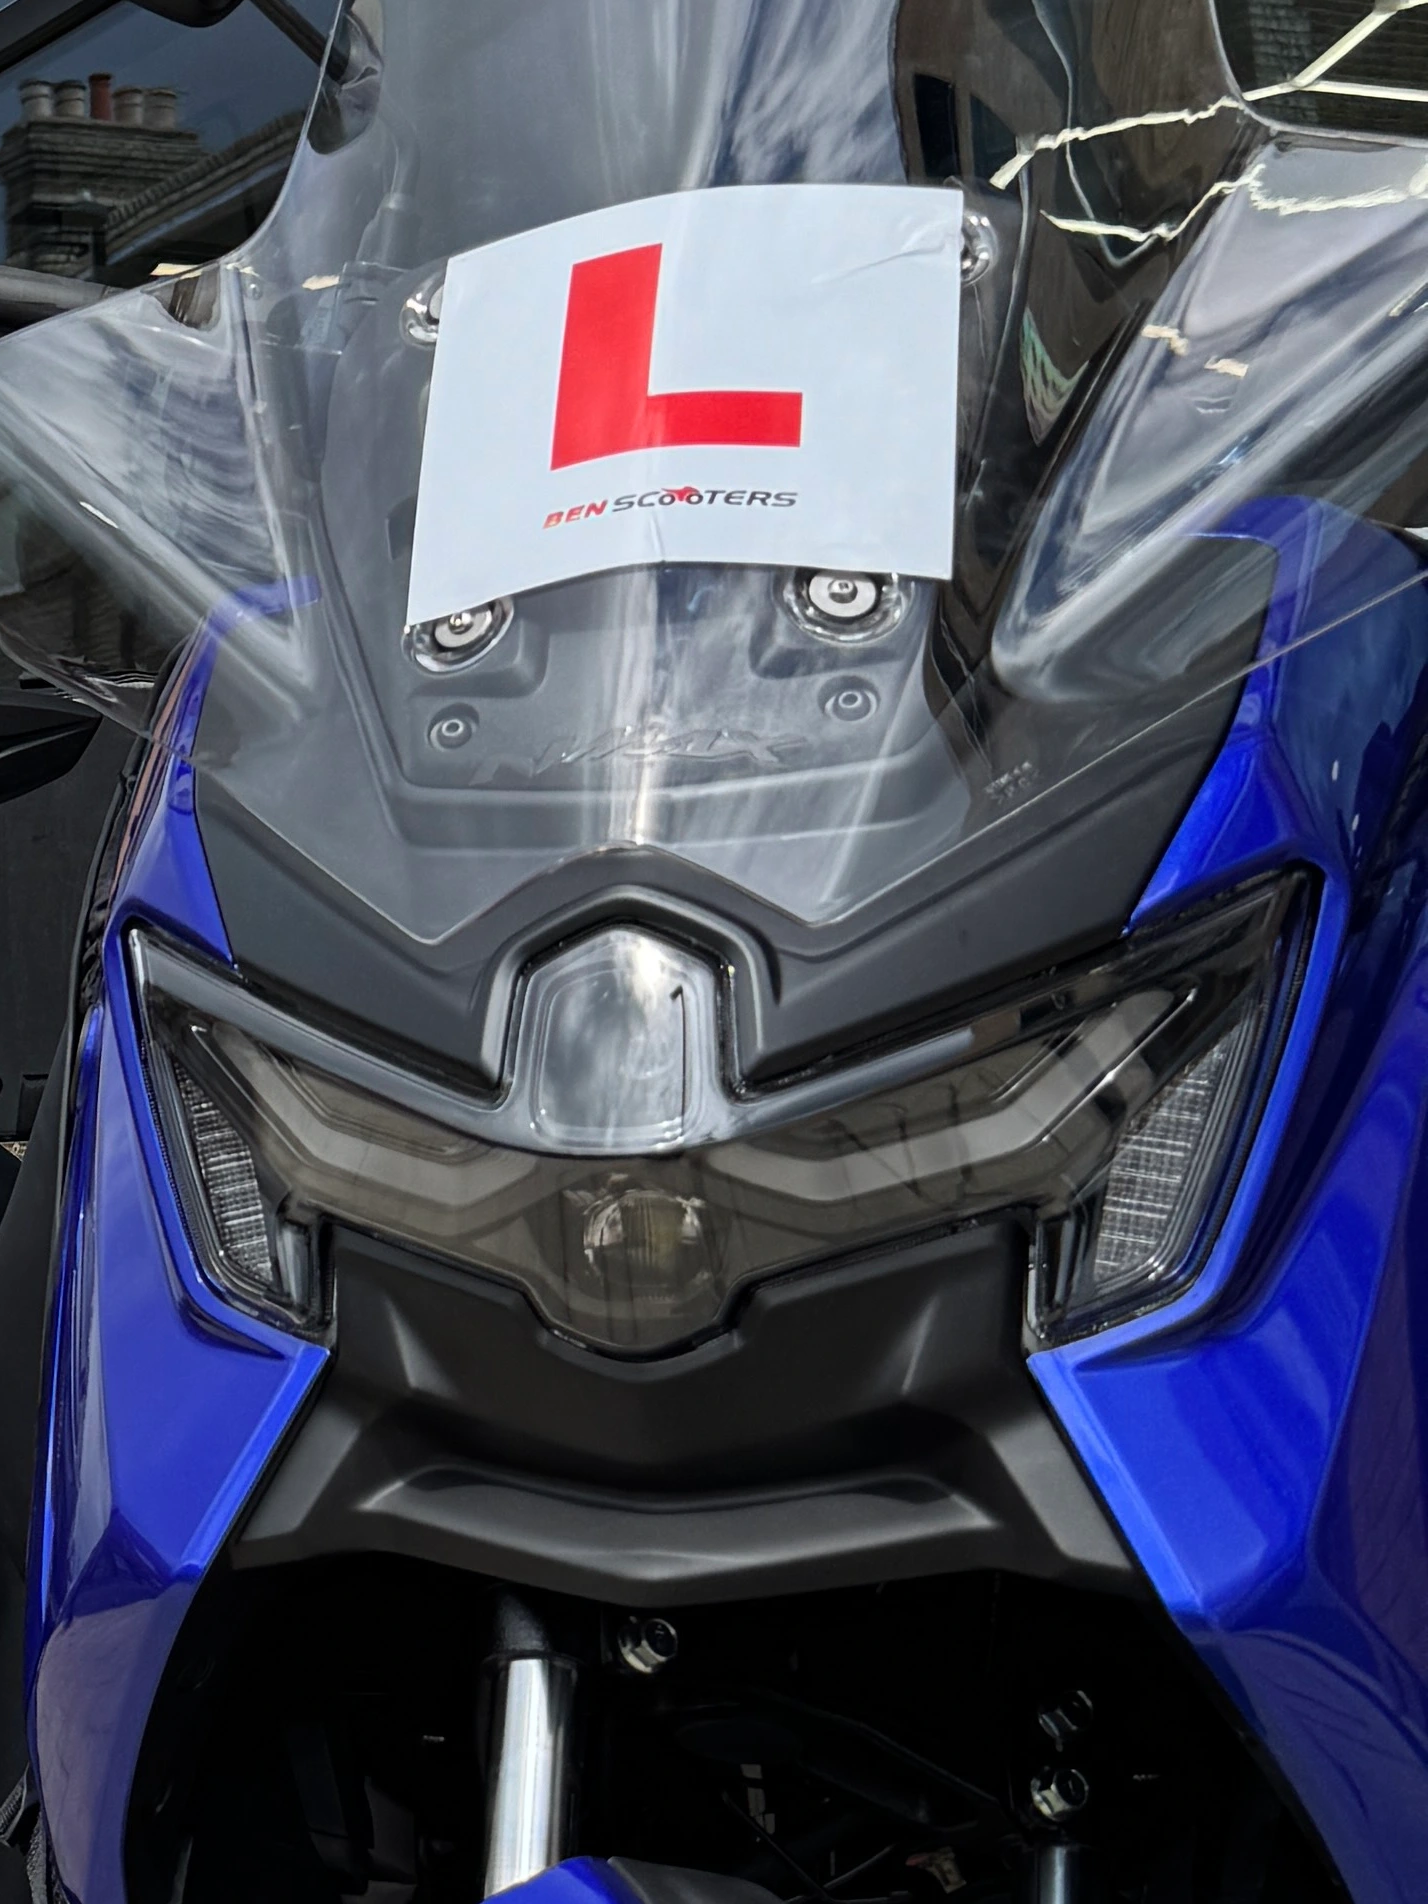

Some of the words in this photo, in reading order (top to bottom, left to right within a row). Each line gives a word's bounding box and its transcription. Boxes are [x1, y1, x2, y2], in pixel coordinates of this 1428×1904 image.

[551, 243, 802, 471] L
[542, 499, 609, 529] BEN
[612, 487, 799, 513] SCOOTERS
